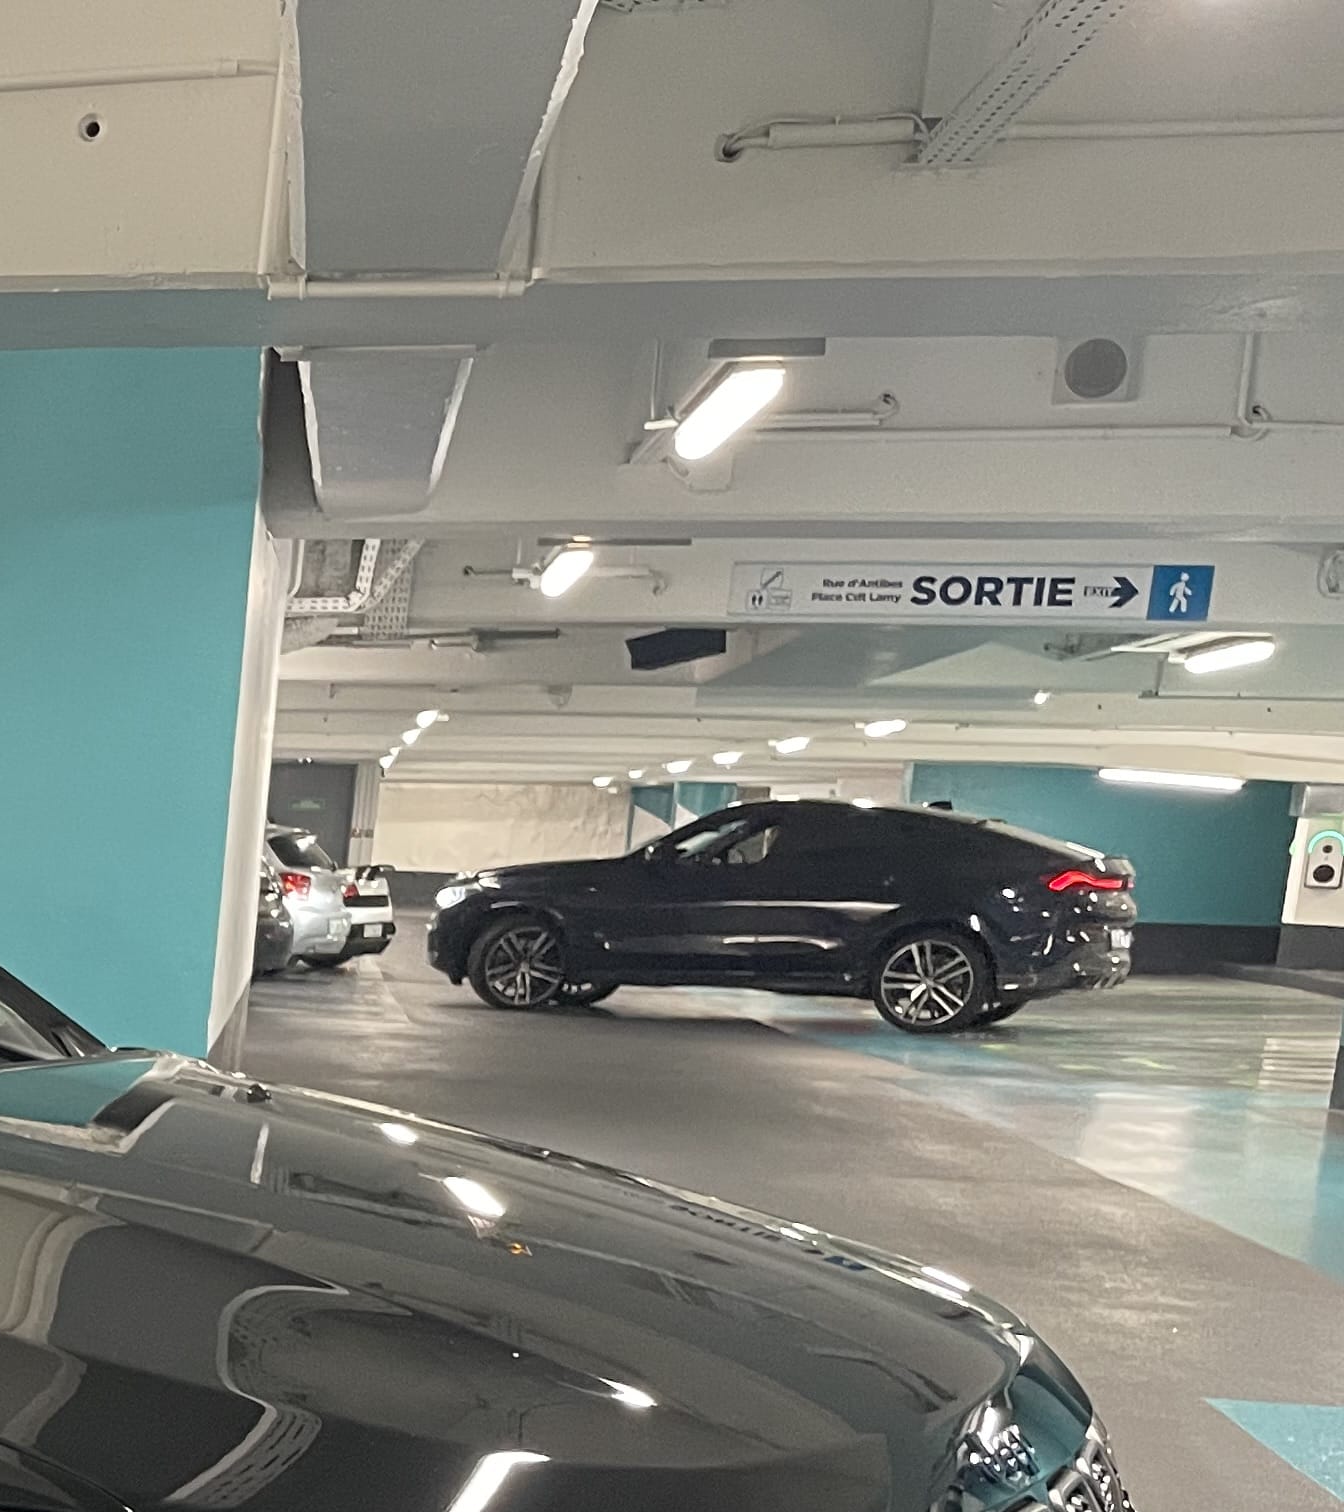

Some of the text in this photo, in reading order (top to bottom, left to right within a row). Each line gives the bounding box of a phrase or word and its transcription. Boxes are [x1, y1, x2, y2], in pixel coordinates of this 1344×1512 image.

[822, 578, 845, 588] Rue
[910, 576, 1113, 606] SORTIE EXIT
[811, 592, 843, 602] Place
[869, 592, 902, 603] Lamy
